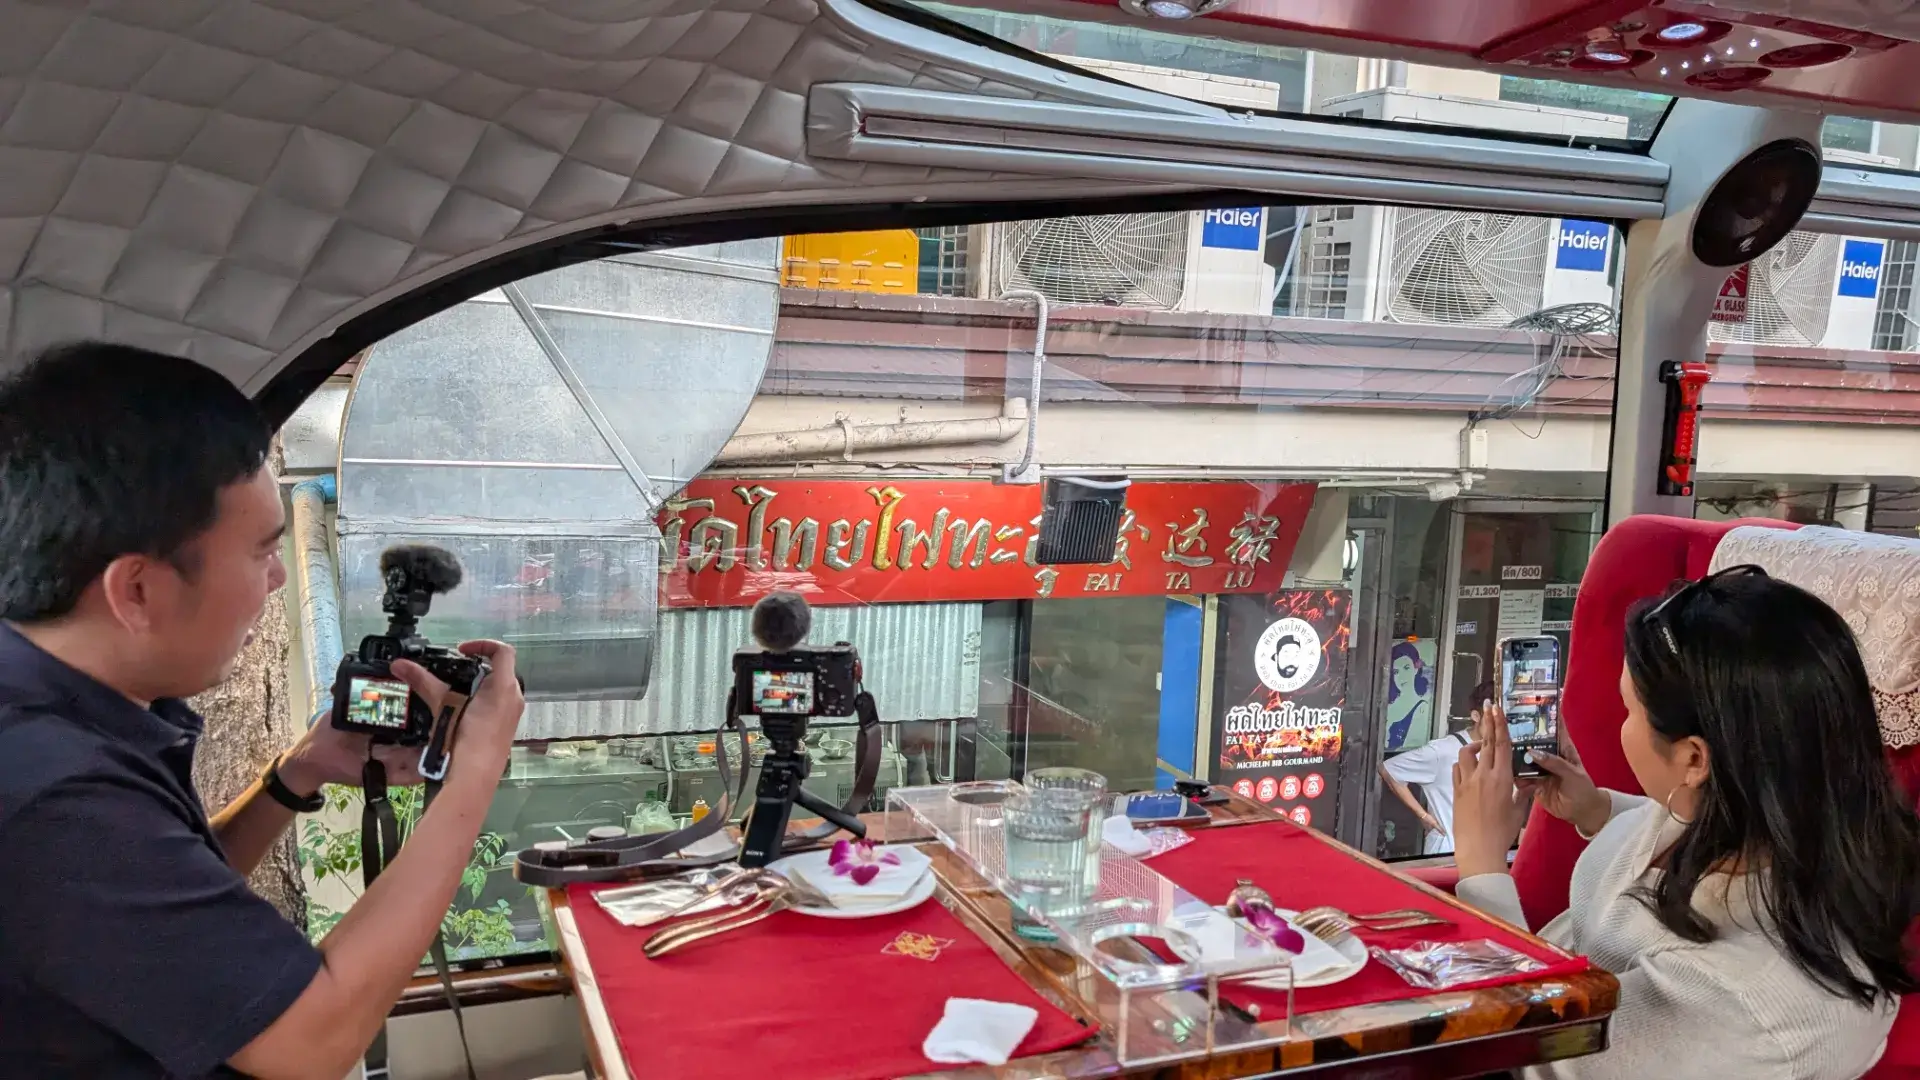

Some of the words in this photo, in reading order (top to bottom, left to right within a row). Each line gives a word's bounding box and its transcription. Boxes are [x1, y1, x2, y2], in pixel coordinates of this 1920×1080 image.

[1206, 208, 1260, 227] Haier
[1560, 229, 1607, 250] Haier
[1841, 260, 1879, 279] Haier
[1724, 299, 1746, 312] GLASS
[1710, 312, 1745, 322] MERGENCY
[1083, 572, 1123, 591] FAI
[1165, 572, 1191, 590] TA
[1224, 571, 1255, 589] LU
[1226, 702, 1341, 733] ผัดไทยไฟทะลุ
[1236, 758, 1270, 769] MICHELIN
[1271, 757, 1283, 767] BIB
[1284, 755, 1324, 766] GOURMAND
